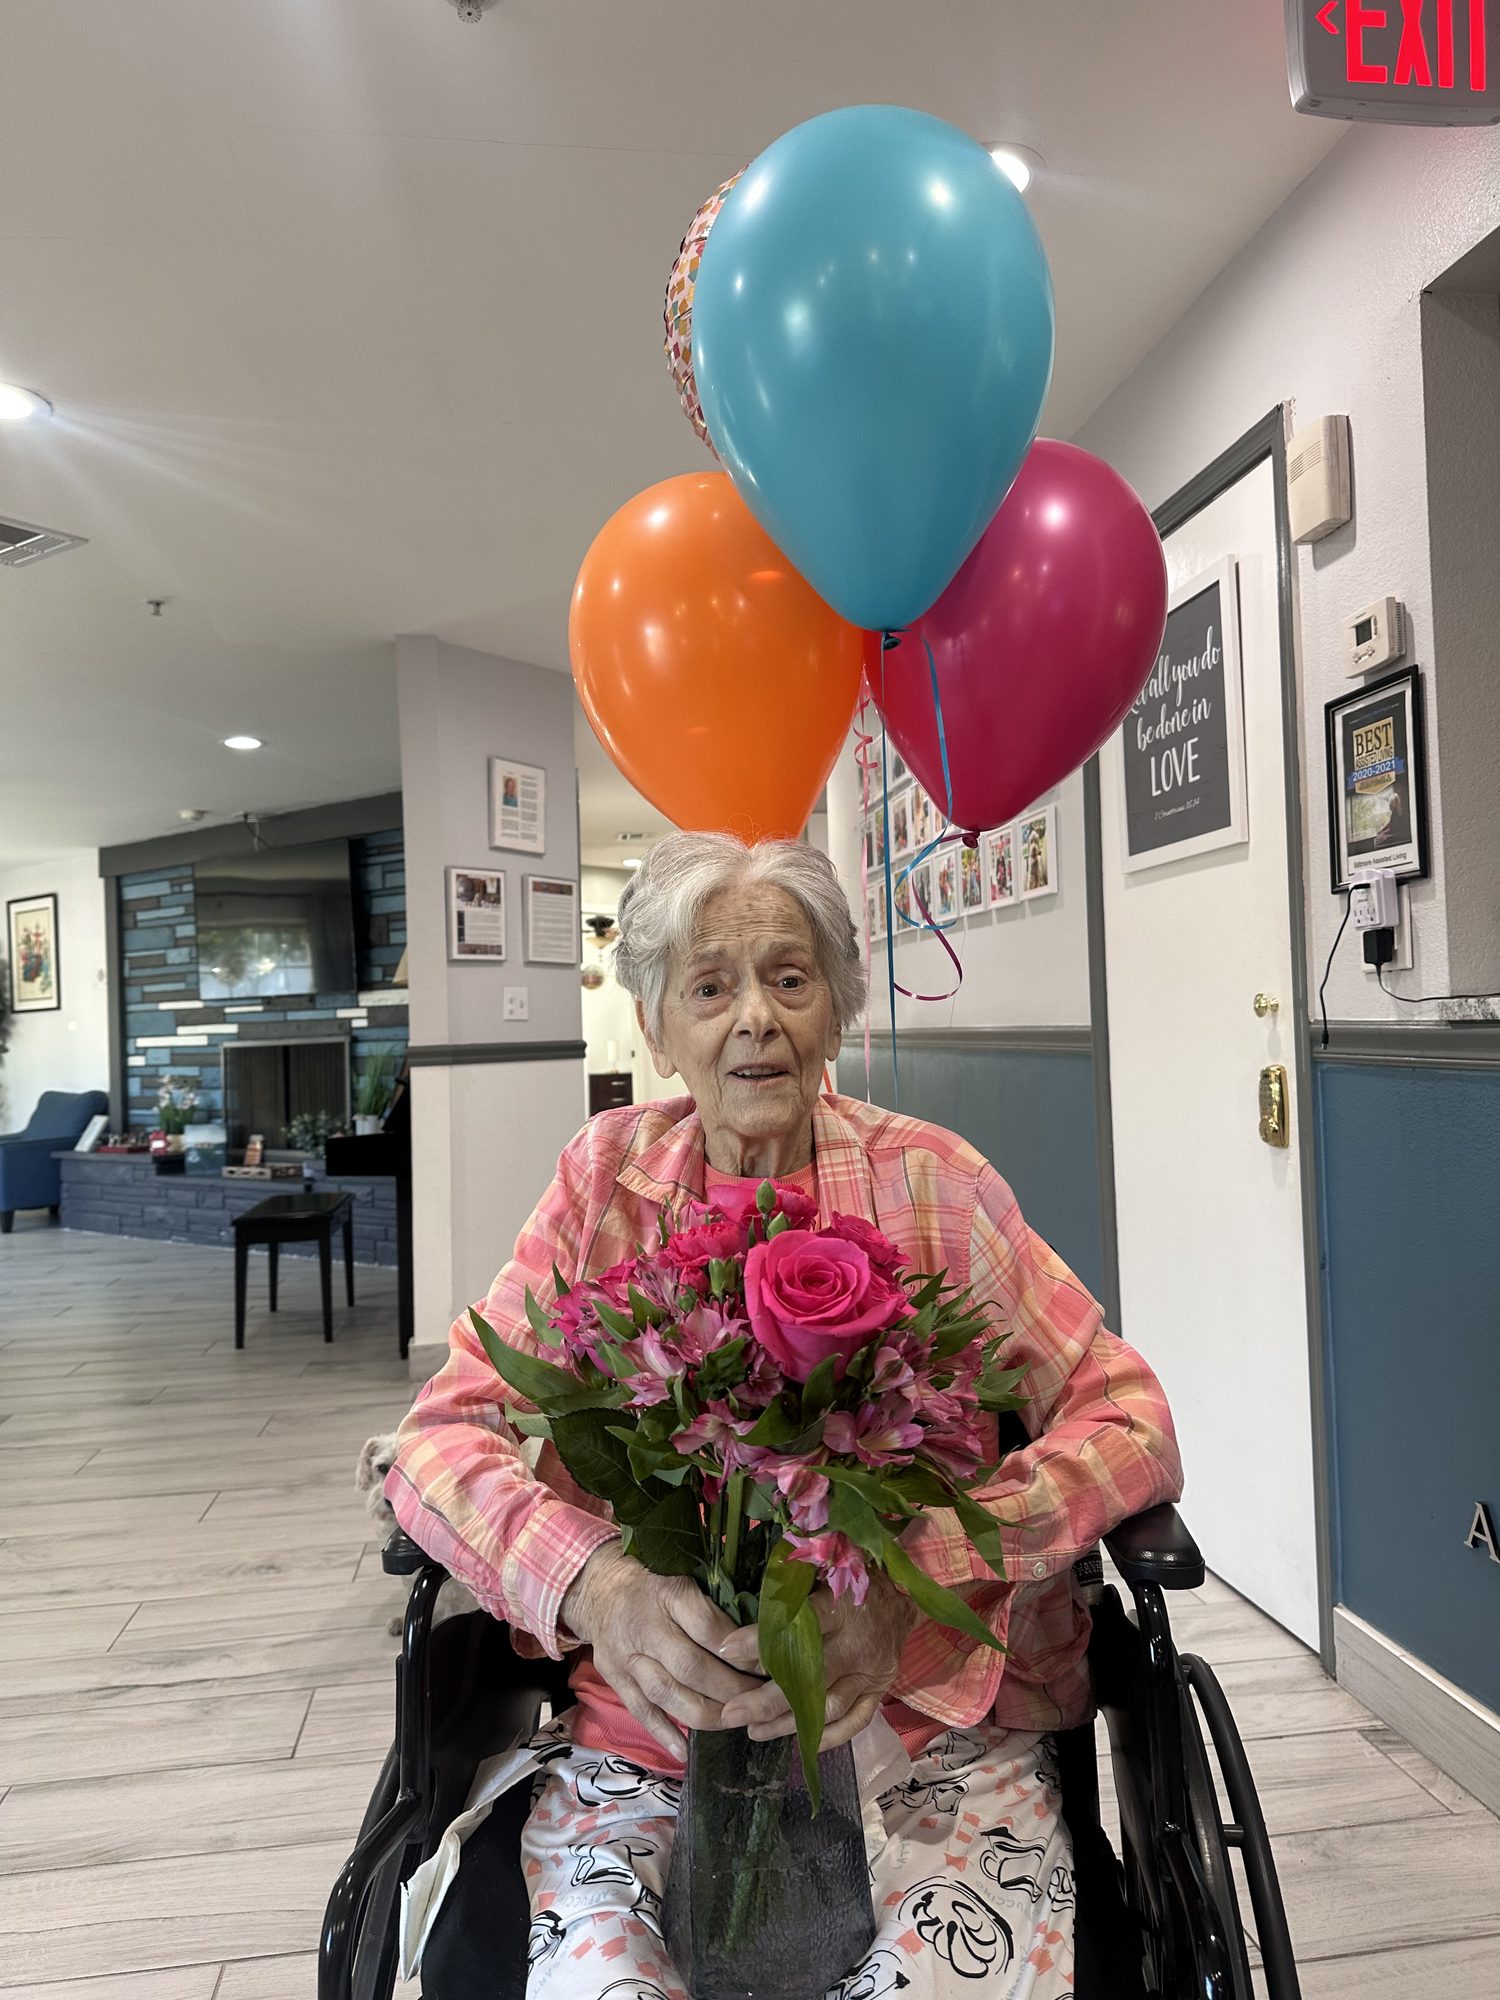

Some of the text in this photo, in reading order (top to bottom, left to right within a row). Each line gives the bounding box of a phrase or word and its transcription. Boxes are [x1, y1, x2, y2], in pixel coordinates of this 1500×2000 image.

[1149, 655, 1171, 698] all
[1172, 656, 1200, 707] you
[1201, 626, 1220, 670] do
[1137, 698, 1212, 751] be done in
[1355, 723, 1391, 757] BEST
[1151, 737, 1200, 797] LOVE
[1353, 760, 1395, 781] 2020-2021
[1463, 1502, 1500, 1565] A
